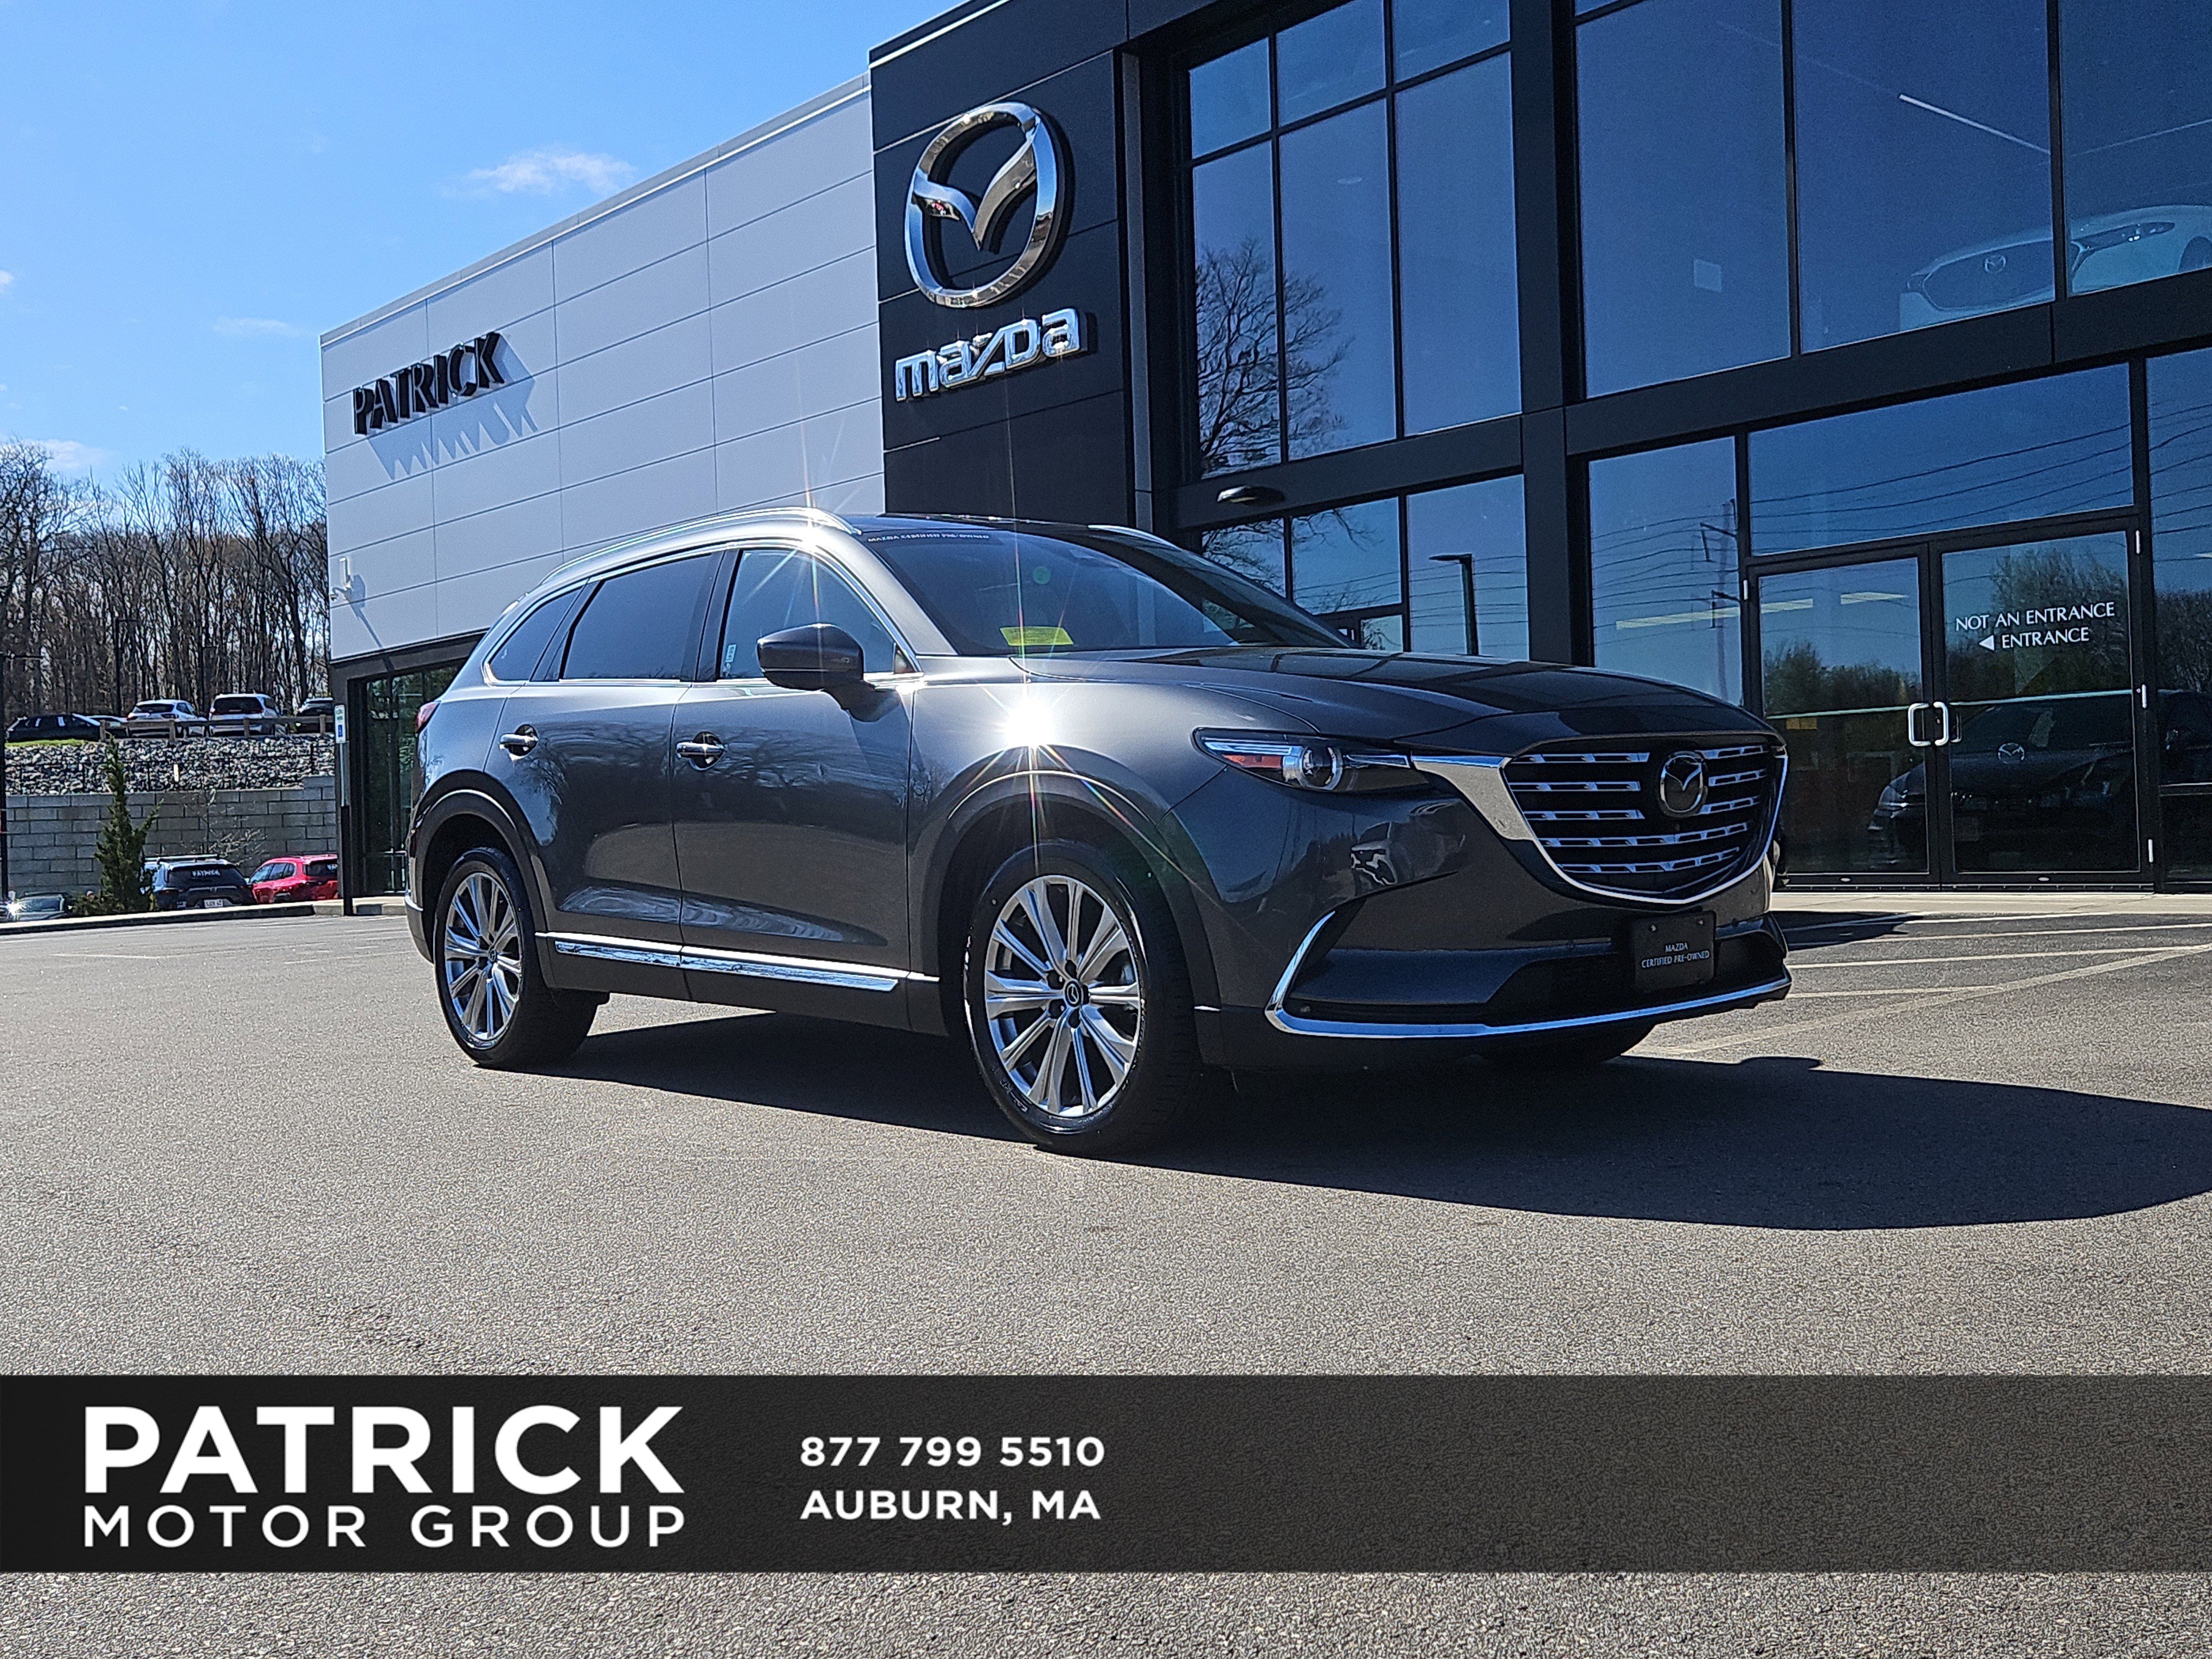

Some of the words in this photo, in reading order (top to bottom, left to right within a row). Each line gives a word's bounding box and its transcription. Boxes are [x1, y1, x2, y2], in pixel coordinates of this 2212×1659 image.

[352, 331, 505, 435] PATRICK
[1956, 614, 1990, 631] NOT
[1995, 611, 2020, 628] AN
[2026, 602, 2115, 625] ENTRANCE
[2002, 627, 2089, 649] ENTRANCE
[1665, 942, 1688, 953] MAZDA
[1641, 956, 1673, 968] CERTIFIED
[1674, 950, 1710, 963] PRE-OWNED
